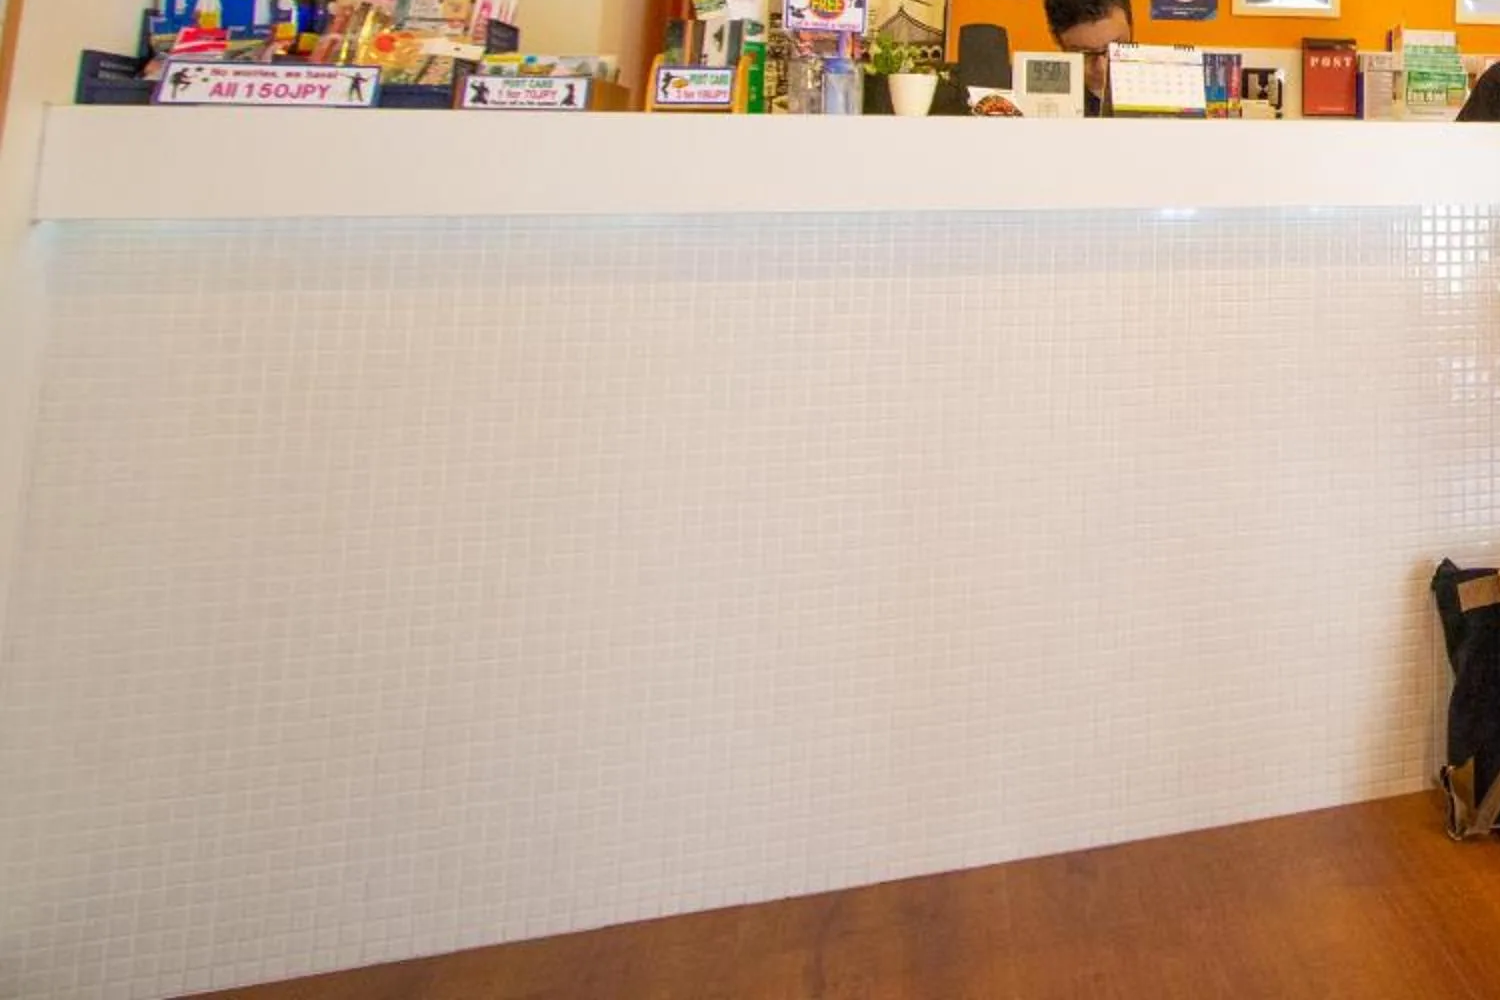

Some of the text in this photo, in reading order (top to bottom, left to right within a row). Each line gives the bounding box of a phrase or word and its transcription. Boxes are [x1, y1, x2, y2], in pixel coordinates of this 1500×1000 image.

[1309, 55, 1353, 68] POST
[210, 68, 228, 77] No
[502, 79, 553, 89] POST CARD
[208, 82, 332, 100] All 150JPY
[505, 89, 521, 99] for
